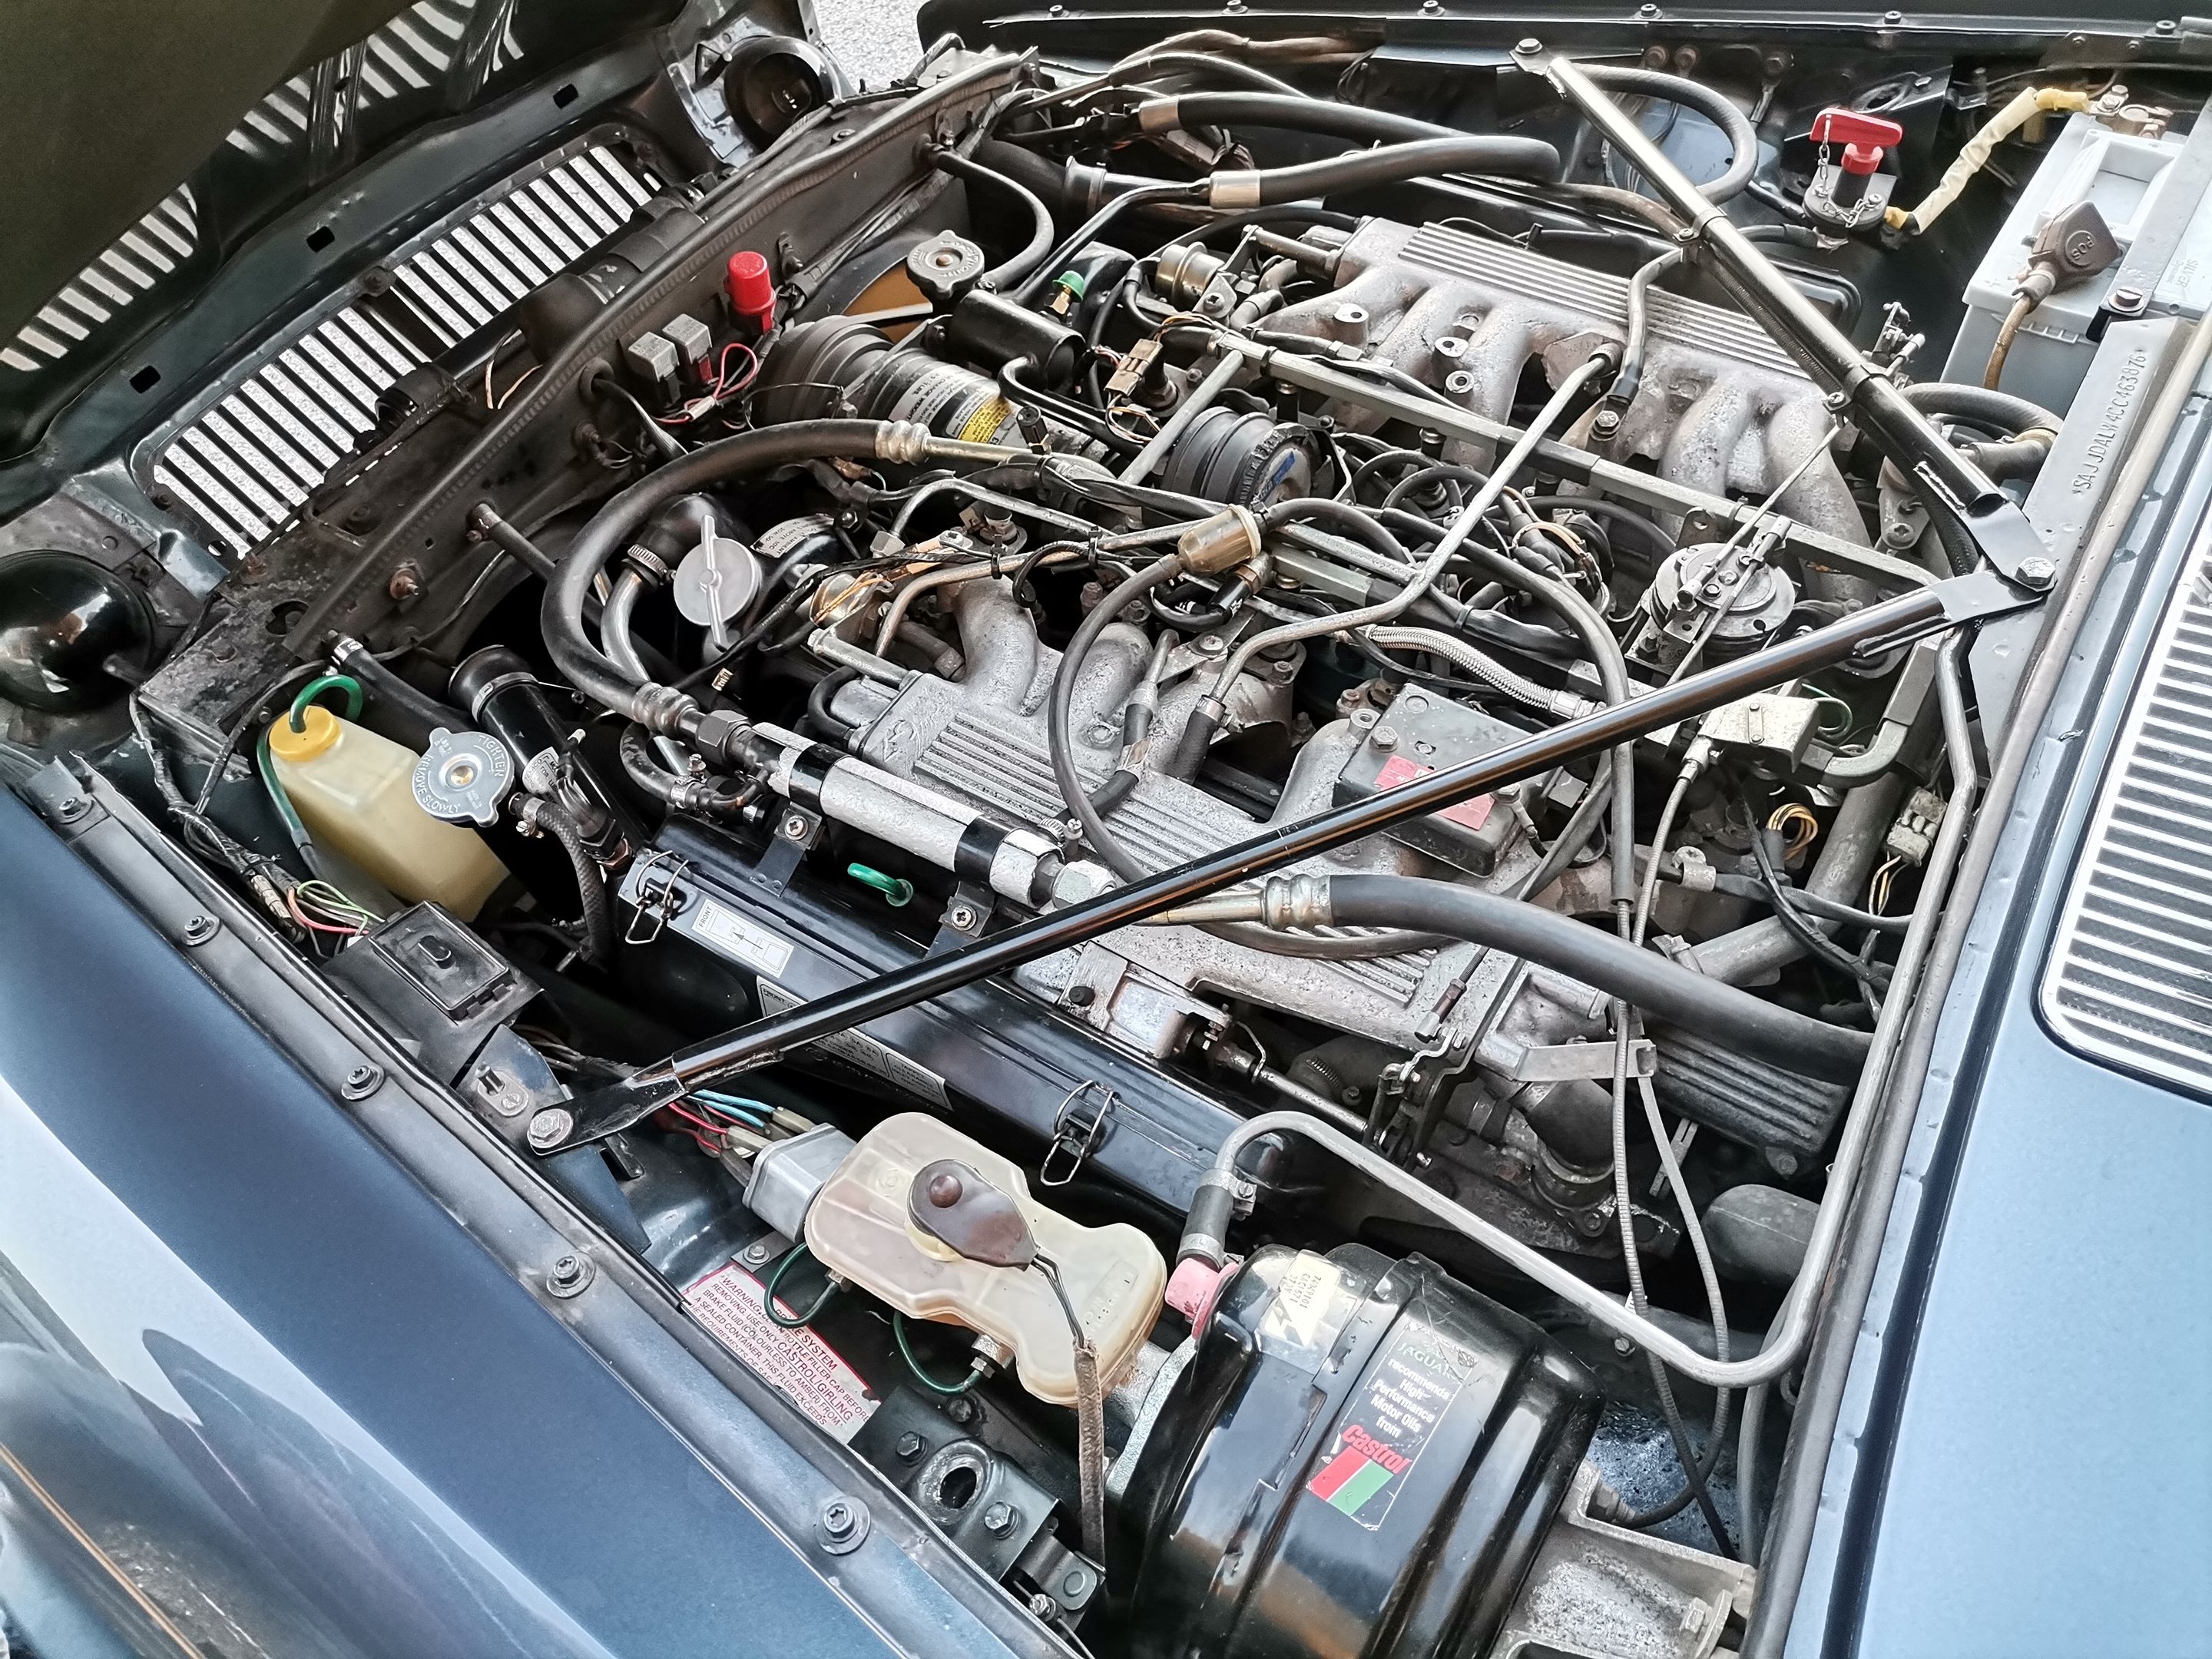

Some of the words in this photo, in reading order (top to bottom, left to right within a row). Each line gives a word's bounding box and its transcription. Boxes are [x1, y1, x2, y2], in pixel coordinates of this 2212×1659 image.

[2071, 237, 2094, 260] POS
[2174, 259, 2198, 287] SILVER
[478, 735, 505, 777] TIGHTEN
[423, 796, 460, 813] SLOWLY
[699, 906, 712, 927] FRONT
[698, 1312, 747, 1358] REQUIREMENTS
[711, 1283, 747, 1315] REMOVING.
[746, 1313, 760, 1328] USE
[759, 1326, 778, 1345] ONLY
[777, 1341, 853, 1420] CASTROL/GIRLING
[722, 1277, 764, 1316] WARNING.
[783, 1333, 808, 1358] BOTTLE
[806, 1356, 830, 1380] FILLER
[829, 1379, 844, 1395] CAP
[843, 1393, 869, 1422] BEFORE
[800, 1333, 837, 1370] SYSTEM
[694, 1294, 702, 1303] A
[700, 1300, 725, 1325] SEALED
[724, 1323, 763, 1360] CONTAINER.
[762, 1358, 777, 1374] THIS
[776, 1373, 796, 1393] FLUID
[794, 1392, 826, 1425] EXCEEDS
[703, 1289, 725, 1310] BRAKE
[724, 1308, 743, 1326] FLUID
[740, 1323, 786, 1367] (COLOURLESS
[785, 1366, 796, 1377] TO
[795, 1376, 821, 1403] AMBER)
[819, 1402, 840, 1425] FROM
[1398, 1342, 1452, 1379] JAGUAR
[1388, 1358, 1450, 1399] recommends
[1398, 1379, 1425, 1401] High
[1370, 1394, 1402, 1421] Motor
[1401, 1413, 1422, 1432] Oils
[1373, 1379, 1435, 1423] Performance
[1376, 1416, 1402, 1438] from
[1342, 1425, 1412, 1475] Castrol
